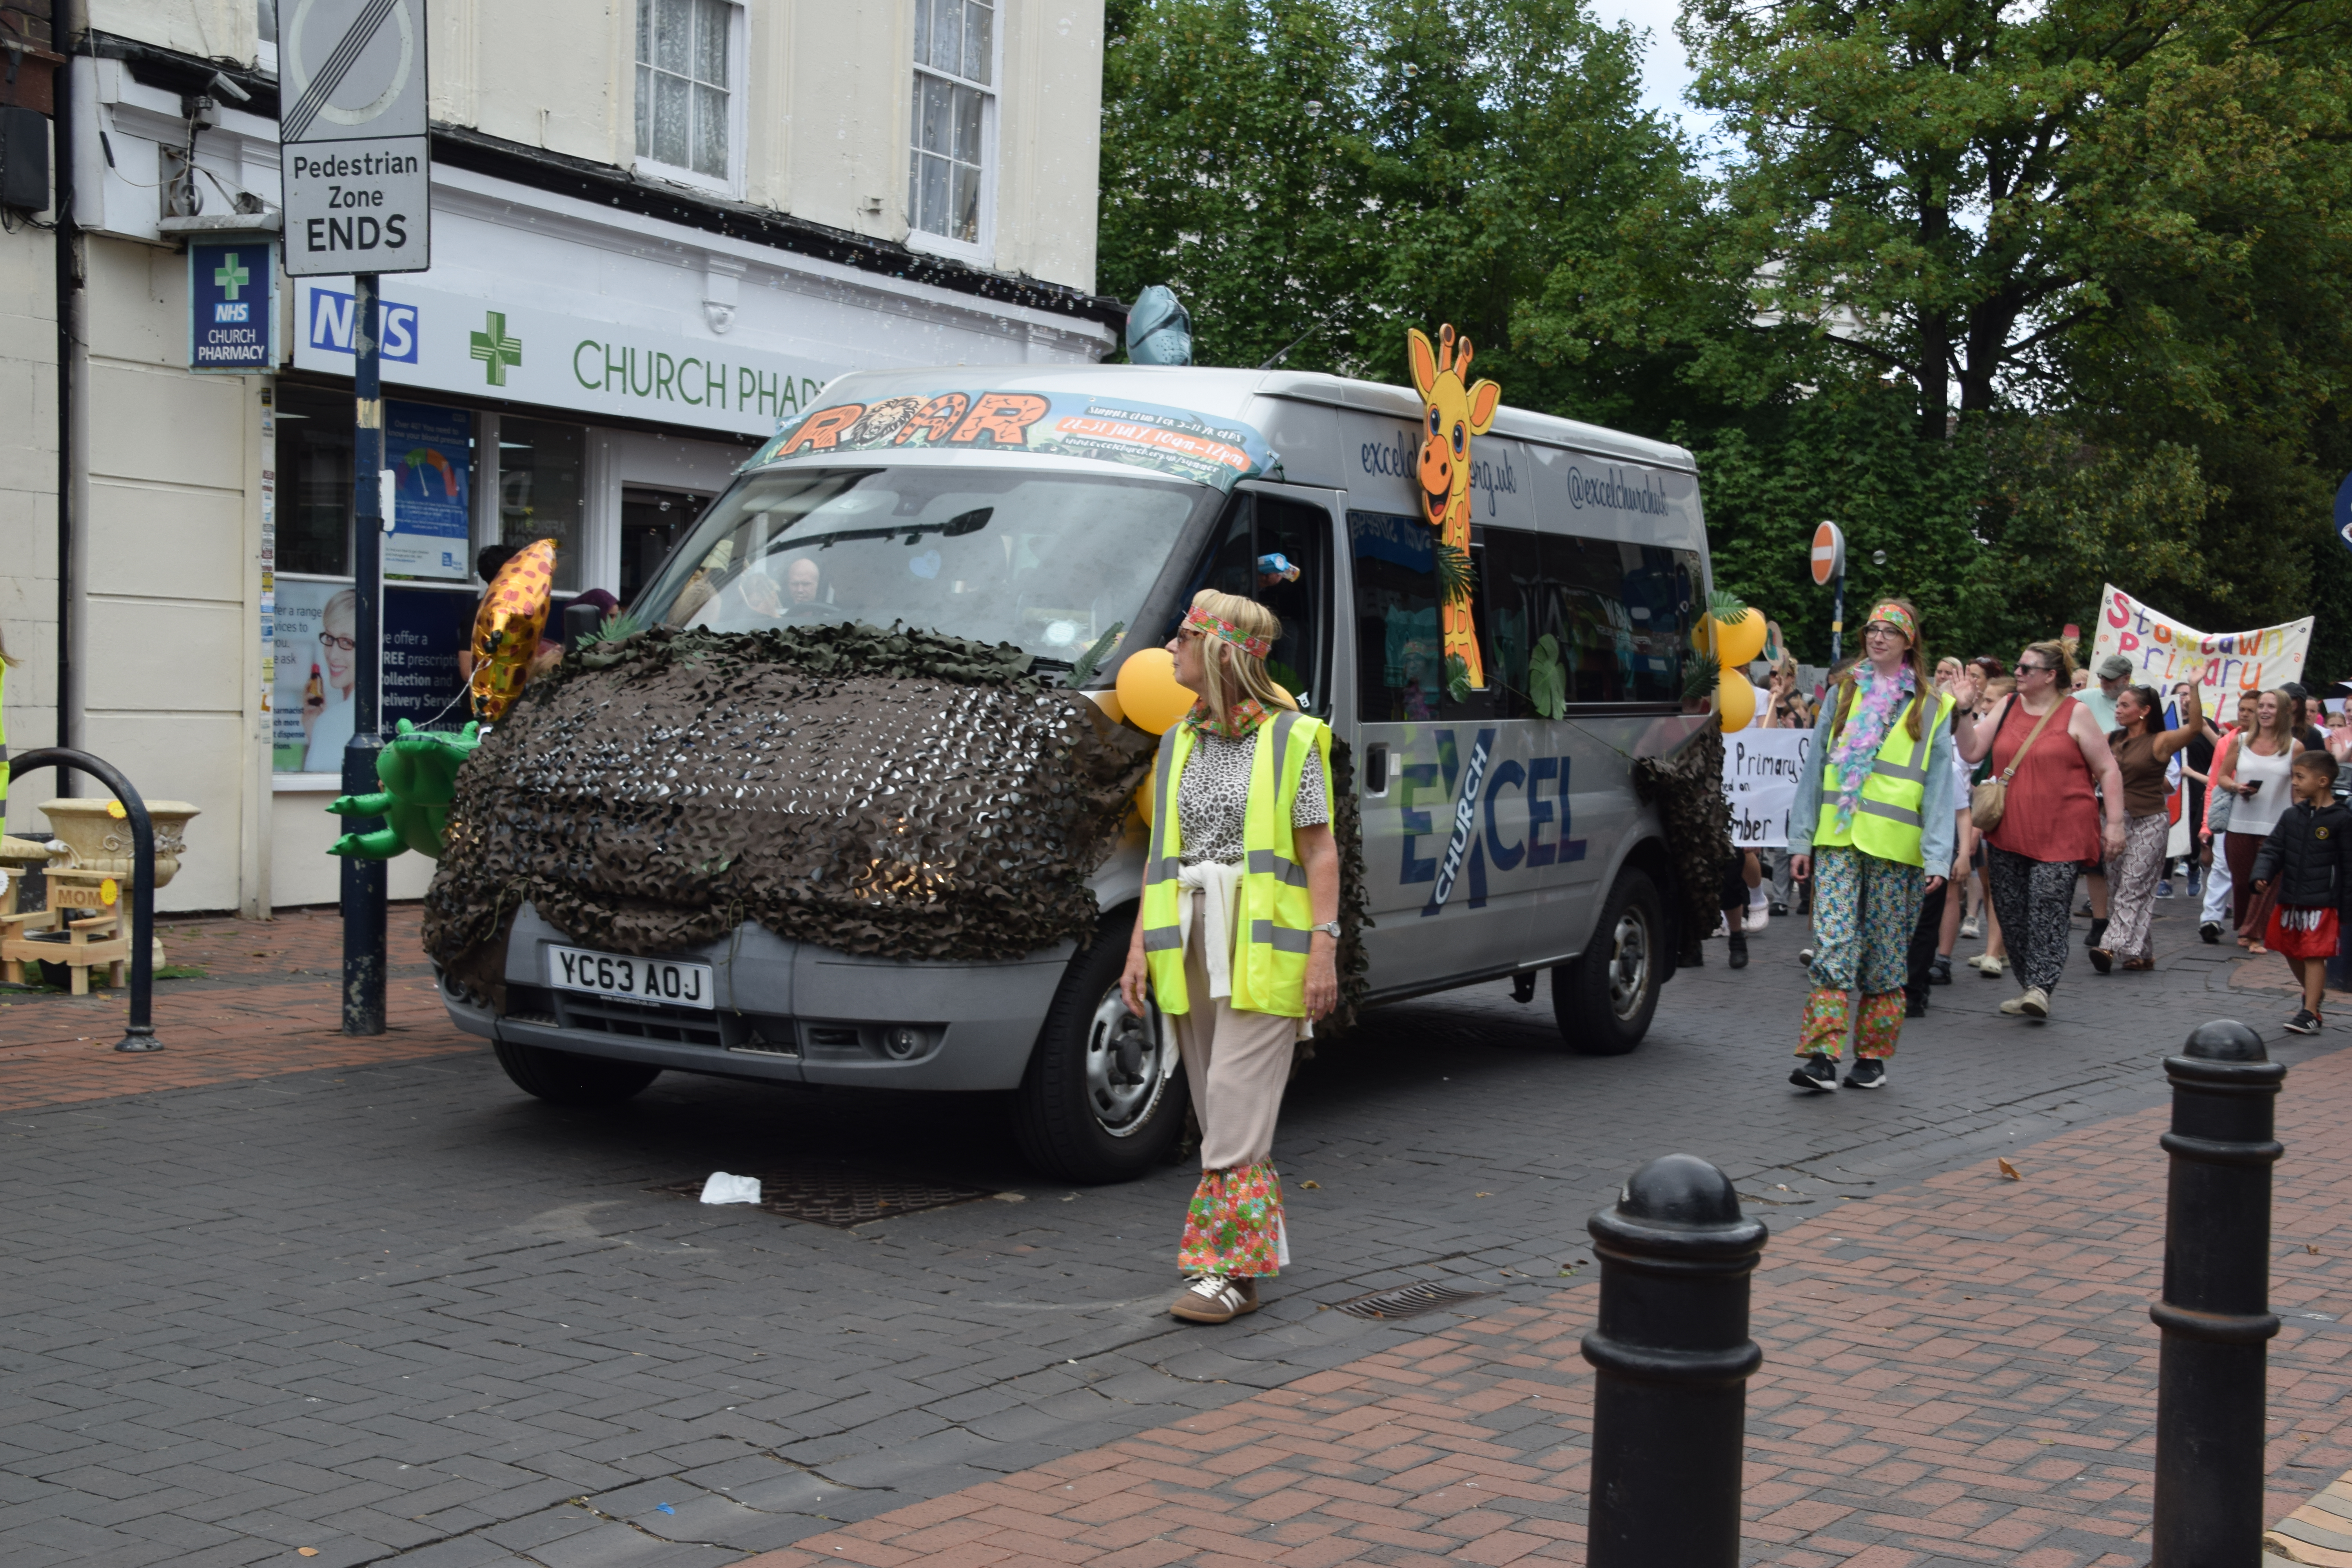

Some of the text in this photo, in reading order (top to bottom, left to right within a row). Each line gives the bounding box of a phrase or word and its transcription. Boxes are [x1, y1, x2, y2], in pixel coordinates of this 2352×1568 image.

[295, 152, 418, 179] Pedestrian
[329, 185, 383, 209] Zone
[308, 214, 407, 252] ENDS
[216, 305, 248, 321] NHS
[209, 329, 256, 344] CHURCH
[199, 346, 264, 360] PHARMACY
[574, 340, 825, 418] CHURCH PHAR
[1062, 419, 1107, 432] 28-31
[297, 608, 322, 620] range
[274, 621, 296, 632] vices
[299, 622, 308, 632] to
[394, 630, 419, 644] offer
[421, 635, 428, 645] a
[281, 652, 296, 664] ask
[383, 651, 405, 665] REE
[434, 674, 453, 686] and
[277, 730, 305, 740] dispense
[381, 721, 392, 734] el:
[1736, 742, 1798, 784] Primary
[1400, 728, 1587, 916] EXCEL
[1435, 743, 1488, 905] CHURCH
[1731, 808, 1771, 841] mber
[560, 951, 700, 1001] YC63 AOJ
